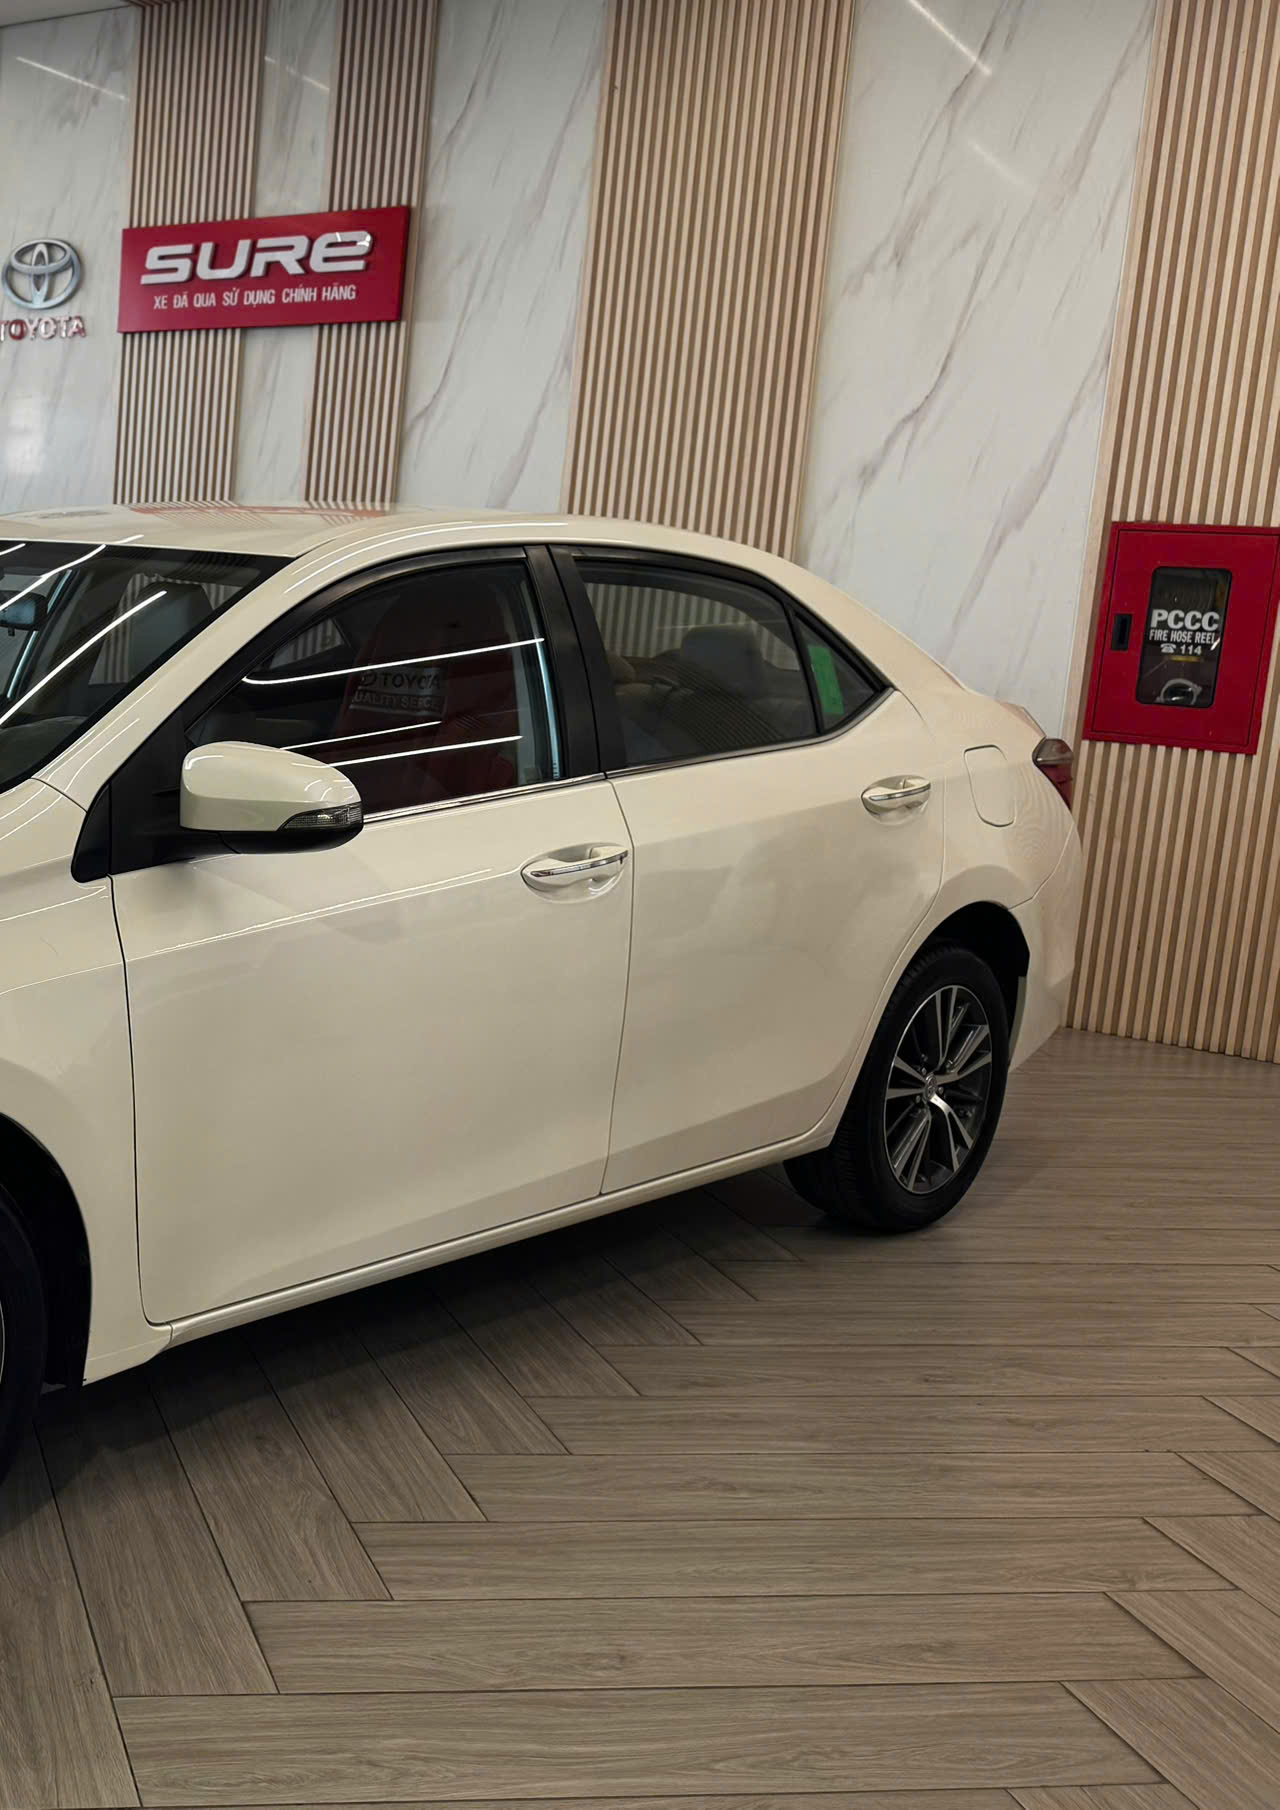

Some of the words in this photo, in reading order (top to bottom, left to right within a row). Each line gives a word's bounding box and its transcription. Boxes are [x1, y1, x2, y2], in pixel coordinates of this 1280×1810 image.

[140, 230, 373, 285] SURE
[154, 295, 168, 309] XE
[193, 293, 216, 308] QUA
[243, 290, 275, 308] DỤNG
[282, 284, 317, 304] CHÍNH
[1151, 609, 1220, 631] PCCC
[1149, 629, 1169, 641] FIRE
[1170, 630, 1193, 643] HOSE
[1194, 632, 1217, 644] REEL
[1180, 644, 1202, 655] 114
